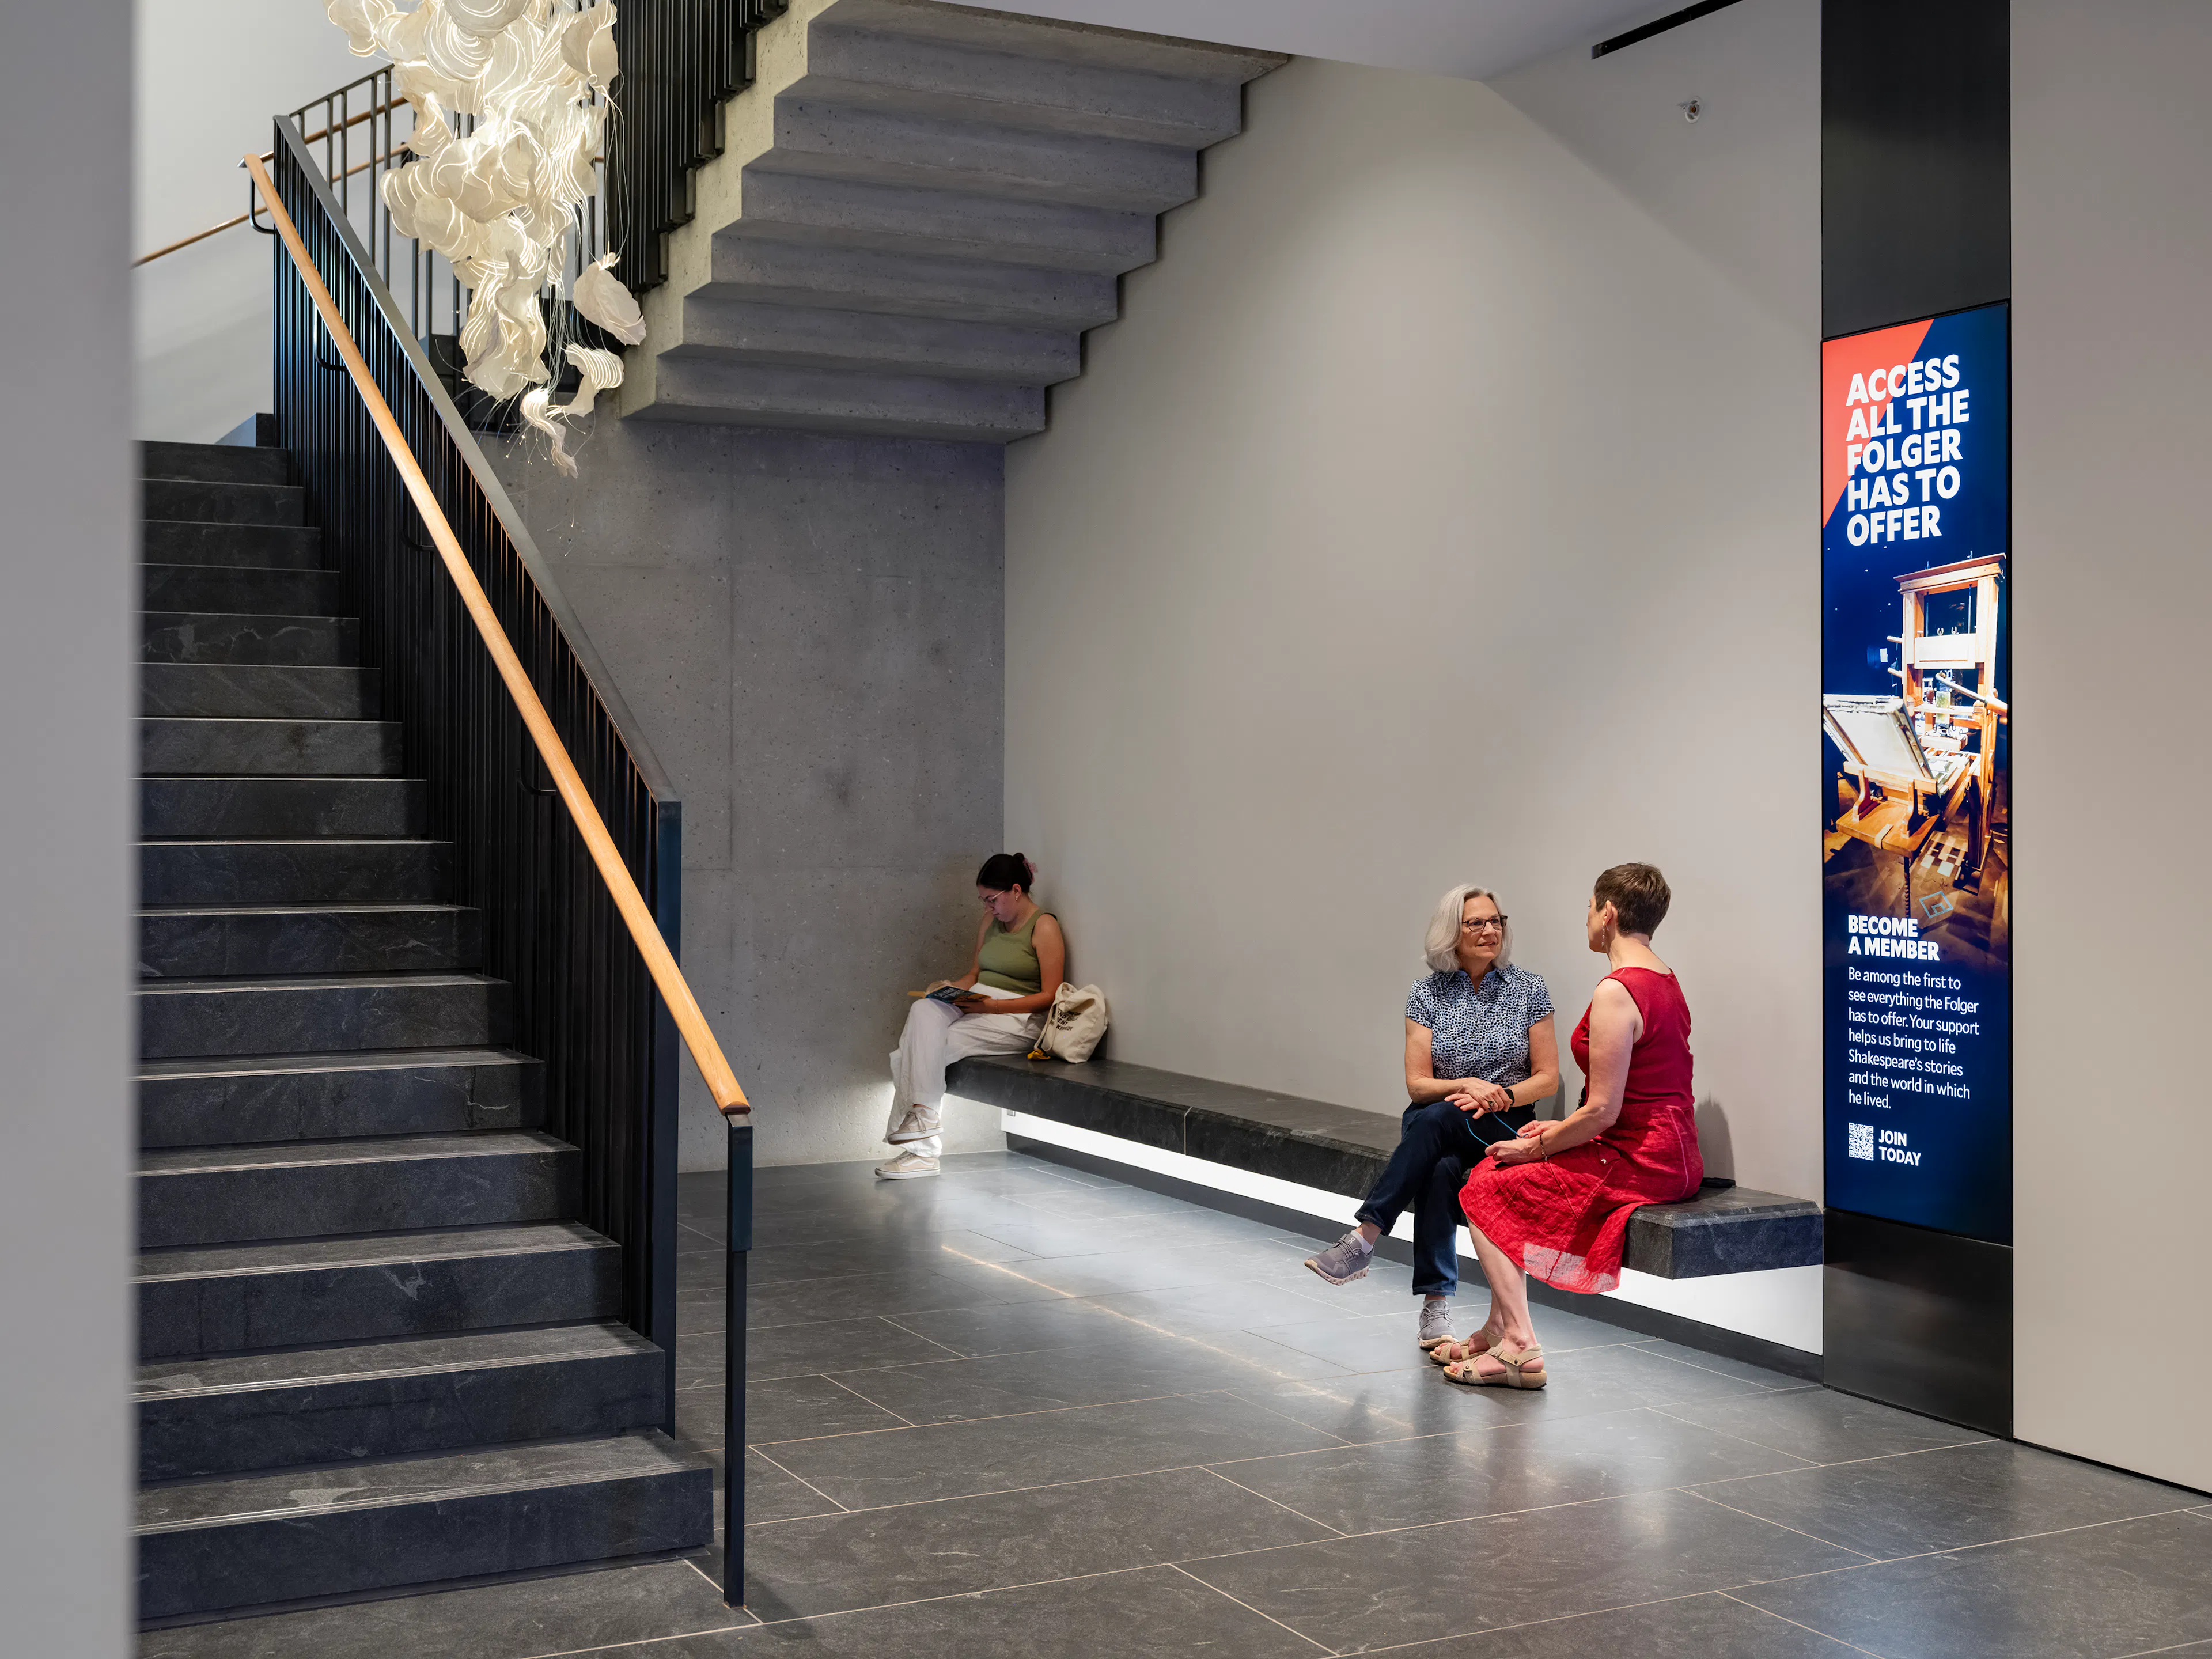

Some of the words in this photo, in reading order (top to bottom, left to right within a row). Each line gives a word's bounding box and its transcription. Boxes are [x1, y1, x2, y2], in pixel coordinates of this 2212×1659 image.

[1846, 355, 1959, 406] ACCESS
[1846, 403, 1901, 441] ALL
[1907, 389, 1969, 430] THE
[1847, 429, 1963, 476] FOLGER
[1848, 473, 1909, 511] HAS
[1916, 466, 1960, 501] TO
[1847, 506, 1942, 546] OFFER
[1849, 915, 1918, 937] BECOME
[1848, 936, 1861, 955] A
[1865, 937, 1940, 960] MEMBER
[1849, 967, 1861, 980] Be
[1863, 972, 1900, 987] among
[1903, 971, 1921, 986] the
[1923, 972, 1946, 988] first
[1948, 977, 1961, 990] to
[1849, 991, 1865, 1001] see
[1868, 991, 1922, 1010] everything
[1925, 995, 1942, 1009] the
[1945, 997, 1979, 1014] Folger
[1849, 1007, 1866, 1022] has
[1868, 1012, 1879, 1023] to
[1881, 1014, 1908, 1027] offer.
[1910, 1014, 1934, 1029] Your
[1936, 1021, 1979, 1035] support
[1849, 1028, 1876, 1046] helps
[1879, 1036, 1891, 1046] us
[1894, 1033, 1921, 1052] bring
[1924, 1039, 1936, 1051] to
[1939, 1038, 1955, 1054] life
[1925, 1060, 1963, 1076] stories
[1849, 1071, 1868, 1084] and
[1870, 1073, 1888, 1087] the
[1891, 1077, 1921, 1092] world
[1925, 1080, 1934, 1093] in
[1937, 1082, 1969, 1099] which
[1849, 1089, 1862, 1104] he
[1864, 1092, 1891, 1108] lived.
[1879, 1130, 1907, 1146] JOIN
[1879, 1146, 1921, 1166] TODAY
